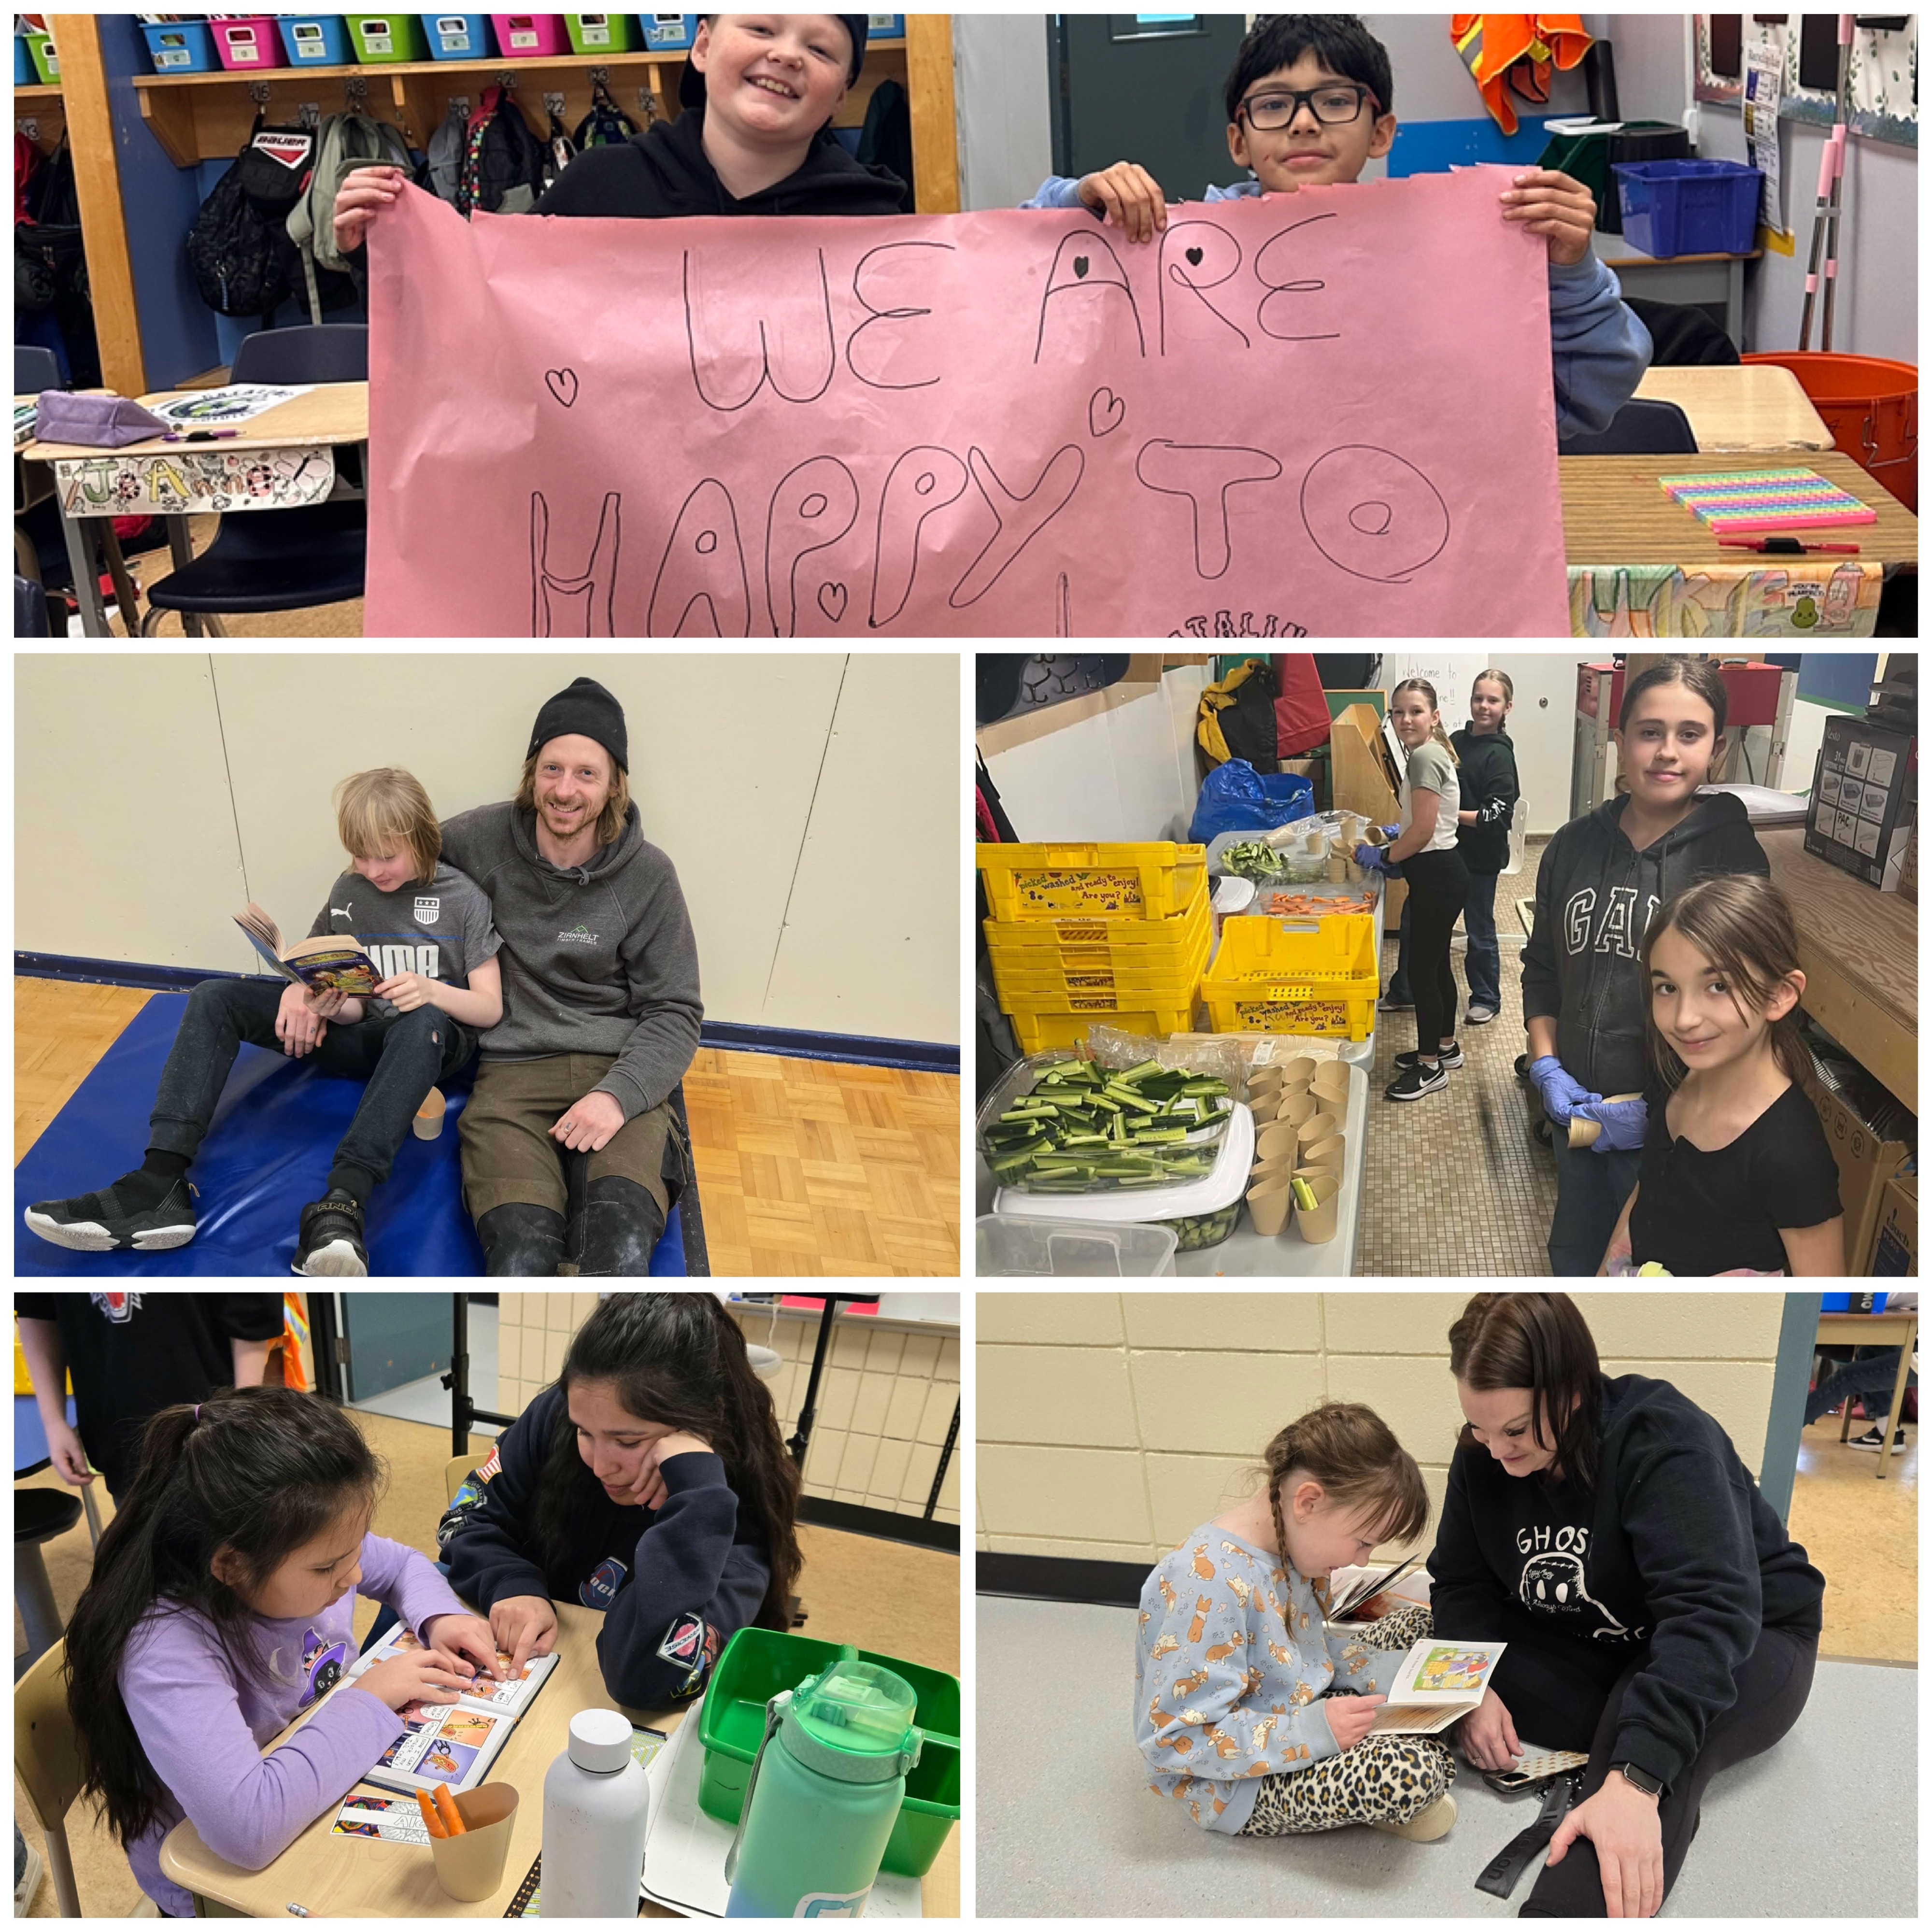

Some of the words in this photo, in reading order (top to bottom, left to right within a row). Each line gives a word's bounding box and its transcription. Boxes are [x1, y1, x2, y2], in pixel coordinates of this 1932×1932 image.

[257, 135, 307, 146] BAUER
[683, 242, 957, 411] WE
[1034, 213, 1341, 364] ARE
[531, 444, 1085, 638] HAPPY
[1136, 438, 1449, 583] TO
[1403, 656, 1440, 678] Welcome
[1448, 663, 1457, 680] to
[1019, 873, 1048, 894] picked
[1041, 875, 1076, 890] washed
[1071, 883, 1084, 891] and
[1085, 876, 1108, 888] ready
[1113, 877, 1139, 890] enjoy!
[1081, 891, 1098, 899] Are
[1100, 891, 1121, 903] you?
[557, 932, 599, 941] ZIRNHELT
[1239, 1002, 1264, 1019] picked
[1260, 1003, 1290, 1015] washed
[1298, 1004, 1318, 1013] ready
[1322, 1004, 1346, 1014] enjoy!
[1310, 1015, 1329, 1024] you?
[1516, 1525, 1593, 1555] GHOS
